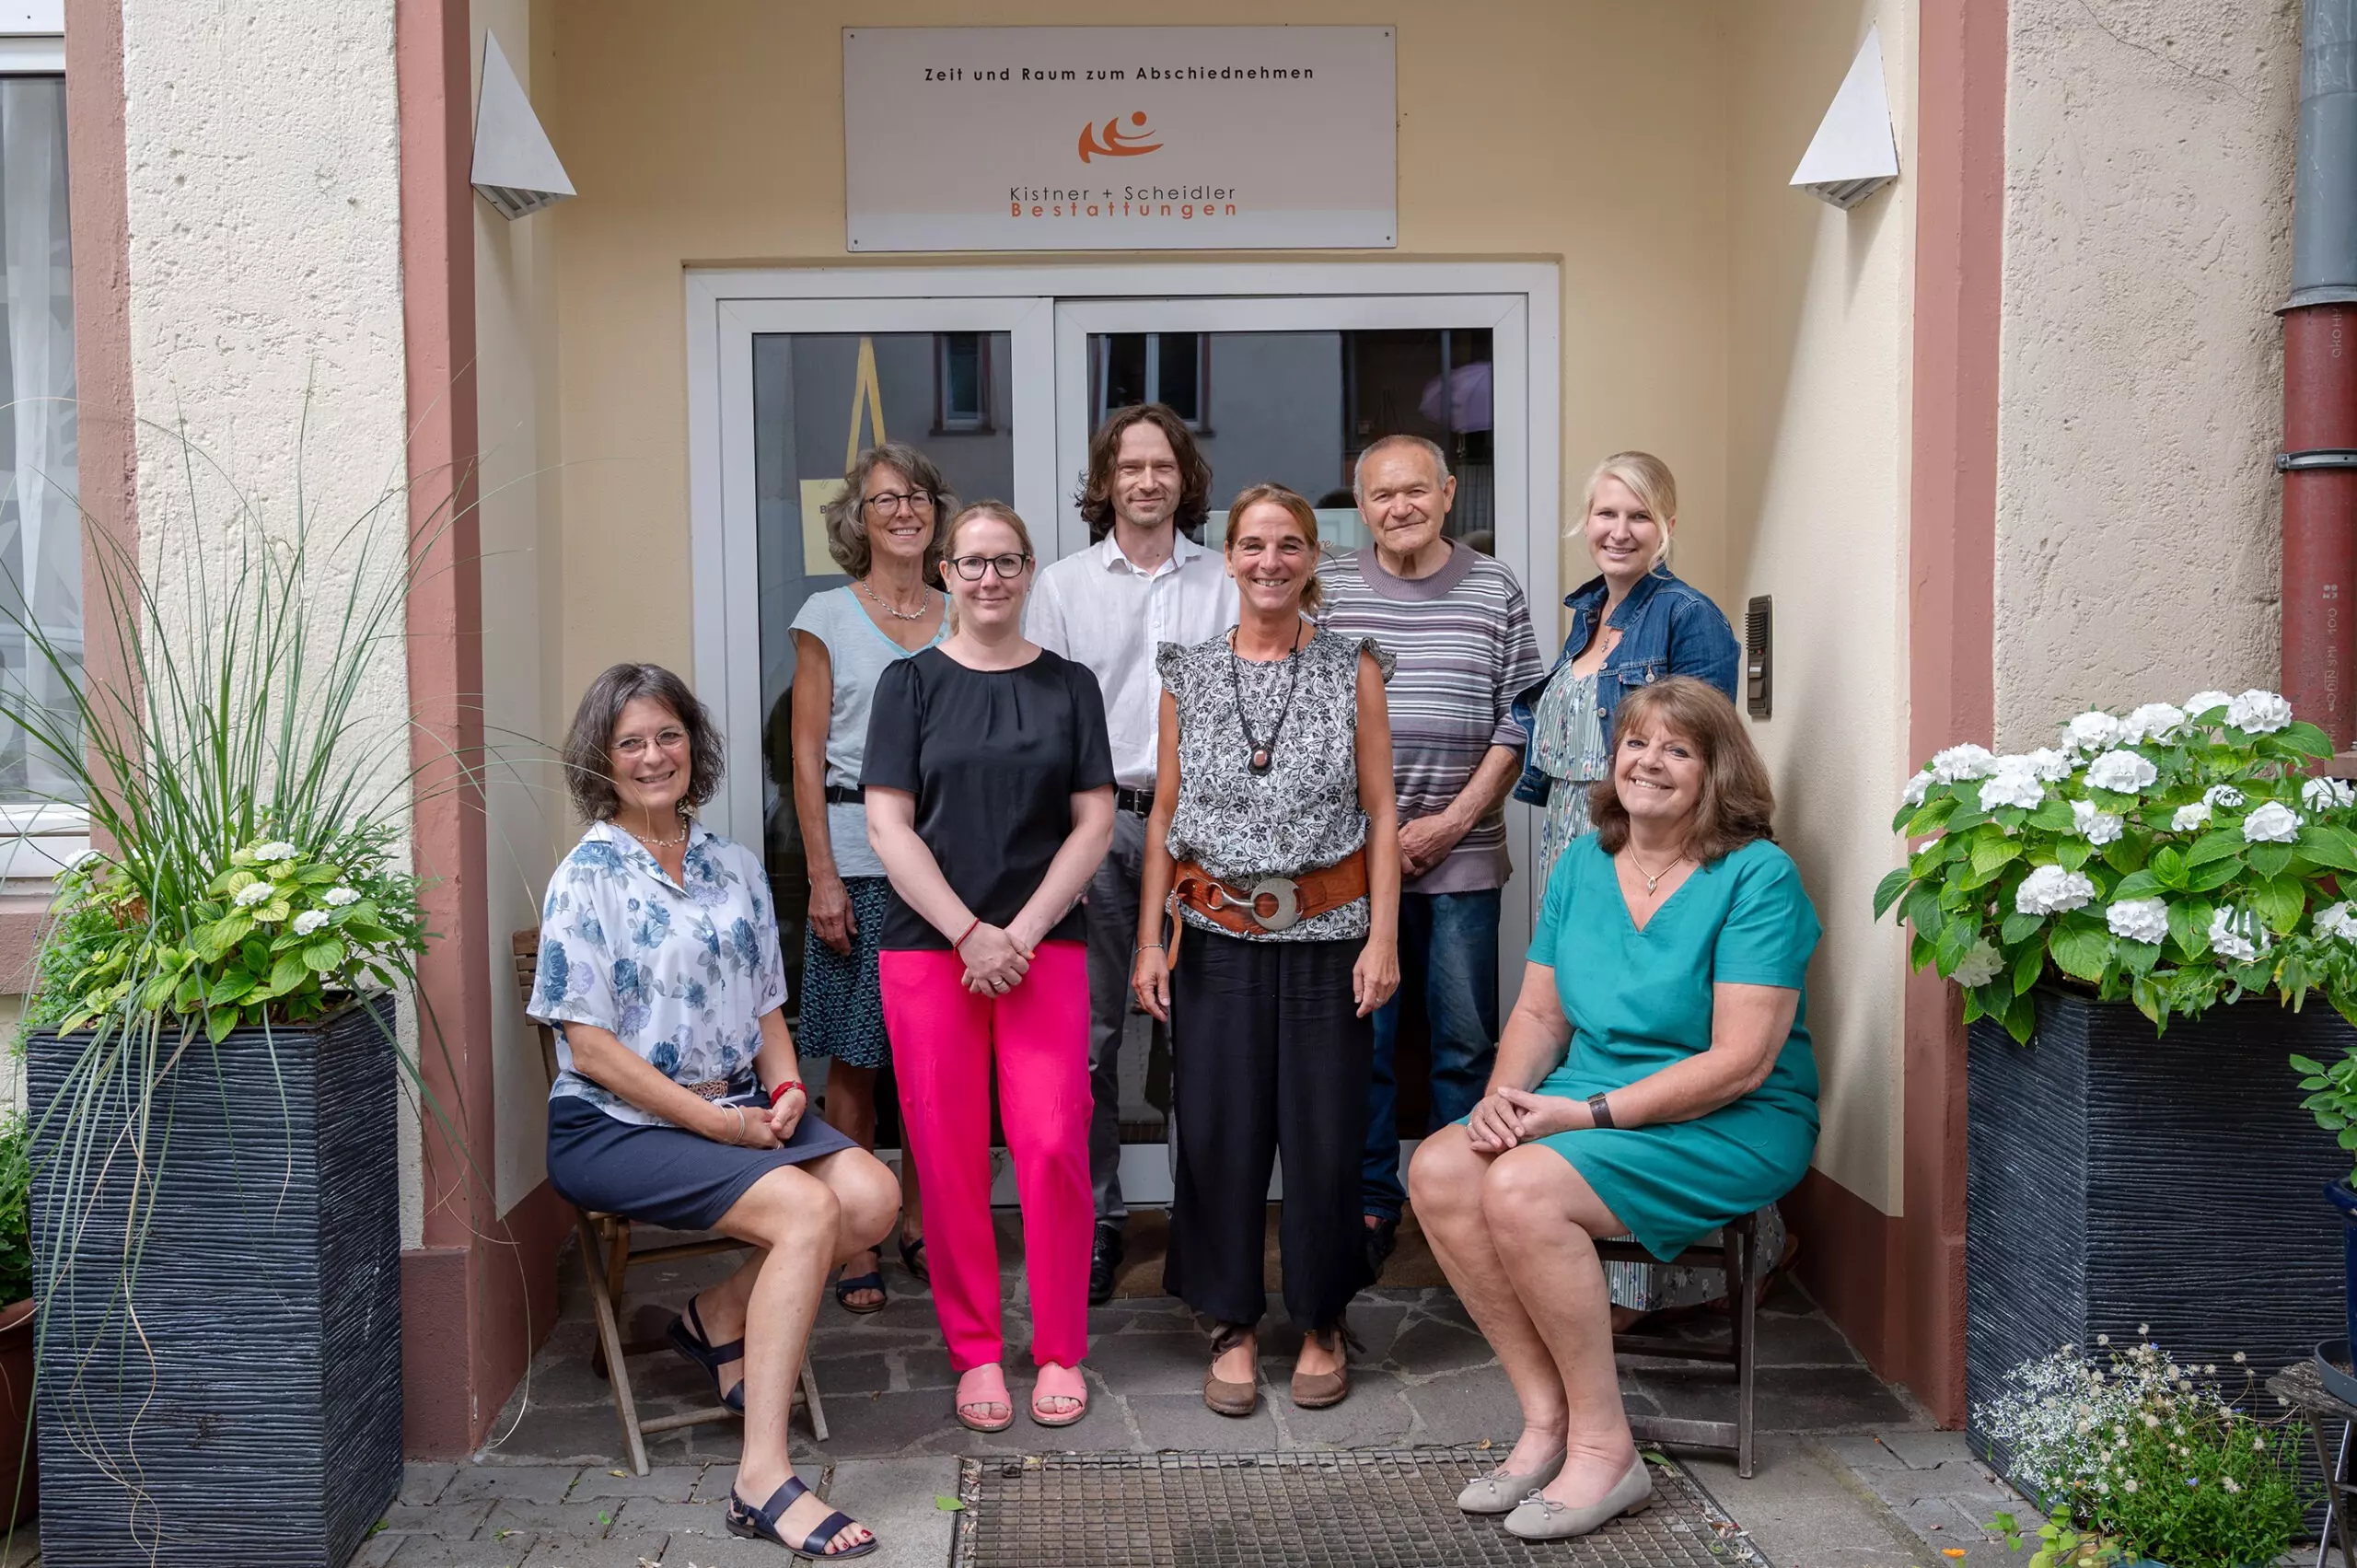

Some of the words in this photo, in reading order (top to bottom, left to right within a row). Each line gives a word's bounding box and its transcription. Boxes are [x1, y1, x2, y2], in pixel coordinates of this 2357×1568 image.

[924, 67, 963, 81] Zeit
[973, 67, 1010, 81] und
[1021, 67, 1076, 81] Raum
[1086, 69, 1125, 81] zum
[1135, 65, 1314, 80] Abschiednehmen
[1010, 186, 1089, 202] Kistner
[1102, 189, 1112, 199] +
[1123, 185, 1236, 201] Scheidler
[1010, 201, 1237, 219] Bestattungen
